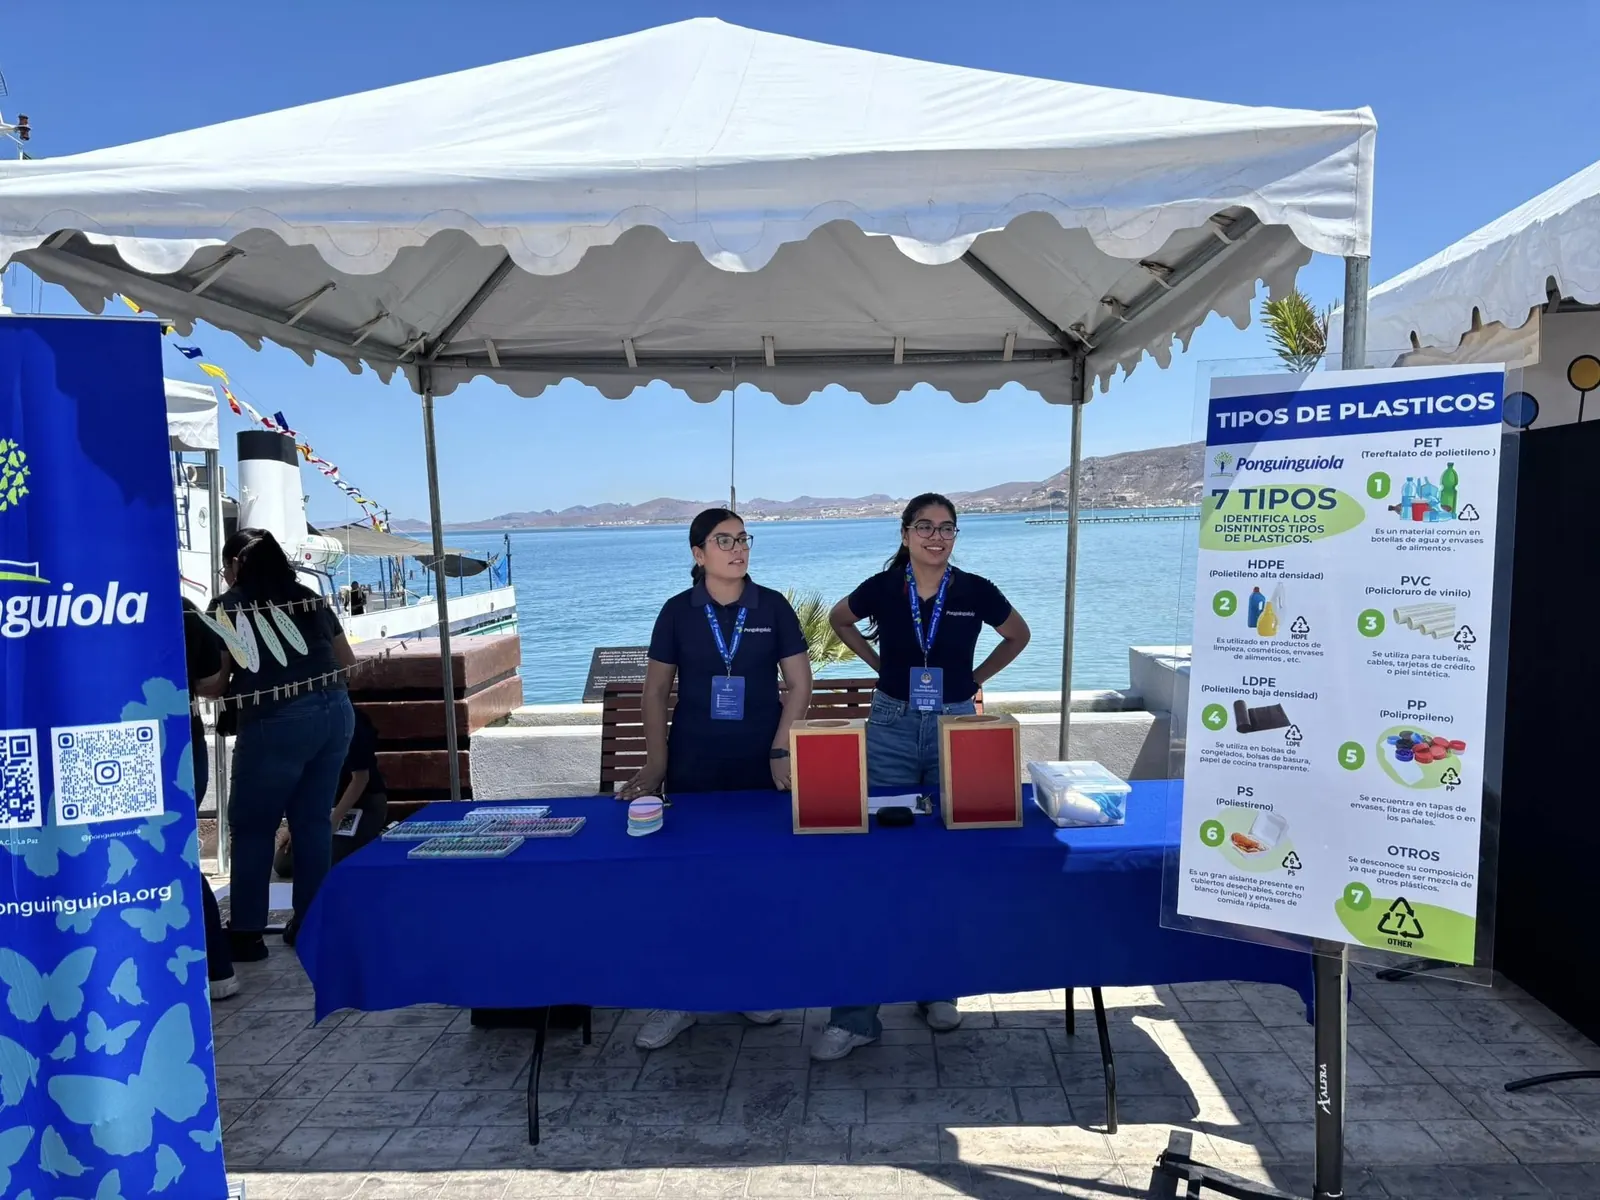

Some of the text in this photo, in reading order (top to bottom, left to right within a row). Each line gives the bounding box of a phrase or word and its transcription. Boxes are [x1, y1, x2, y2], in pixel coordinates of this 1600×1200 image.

[1216, 392, 1495, 429] TIPOS DE PLASTICOS
[1414, 437, 1442, 448] PET
[1361, 450, 1417, 459] (Tereftalato
[1436, 448, 1490, 458] polietileno
[1236, 455, 1344, 473] Ponguinguiola
[1374, 478, 1382, 492] 1
[1212, 488, 1337, 510] 7 TIPOS
[1223, 514, 1317, 523] IDENTIFICA LOS
[1215, 524, 1325, 533] DISNTINTOS TIPOS
[1224, 534, 1313, 544] DE PLASTICOS.
[1248, 559, 1285, 570] HDPE
[1279, 572, 1324, 580] densidad)
[1400, 576, 1431, 586] PVC
[1365, 587, 1421, 595] (Policloruro
[1440, 589, 1471, 598] vinilo)
[0, 581, 148, 638] guiola
[1220, 598, 1230, 610] 2
[1365, 616, 1377, 630] 3
[1271, 640, 1309, 648] productos
[1247, 647, 1291, 655] cosméticos,
[1245, 654, 1281, 662] alimentos
[1432, 653, 1470, 663] tuberías,
[1397, 661, 1428, 669] tarjetas
[1444, 662, 1475, 671] crédito
[1412, 669, 1450, 678] sintética.
[1242, 676, 1276, 687] LDPE
[1201, 685, 1318, 700] (Polietileno baja densidad)
[1407, 700, 1427, 710] PP
[1208, 710, 1221, 724] 4
[1380, 710, 1454, 723] (Polipropileno)
[1226, 742, 1248, 750] utiliza
[1201, 749, 1244, 758] congelados,
[1283, 756, 1311, 764] basura,
[1346, 749, 1357, 763] 5
[1259, 762, 1309, 772] transparente.
[1237, 786, 1254, 797] PS
[1216, 798, 1274, 812] (Poliestireno)
[1371, 796, 1414, 806] encuentra
[1429, 803, 1453, 811] tapas
[1350, 802, 1385, 812] envases,
[1387, 806, 1410, 815] fibras
[1426, 811, 1454, 820] tejidos
[1401, 816, 1436, 826] pañales.
[1207, 827, 1217, 840] 6
[1388, 846, 1440, 861] OTROS
[1360, 858, 1405, 870] desconoce
[1419, 867, 1474, 880] composición
[1229, 875, 1257, 884] aislante
[1260, 880, 1293, 888] presente
[1377, 877, 1440, 892] otros plásticos.
[1379, 870, 1410, 879] pueden
[1428, 876, 1458, 886] mezcla
[1191, 877, 1302, 898] cubiertos desechables, corcho
[1220, 889, 1247, 899] (unicel)
[1256, 896, 1285, 904] envases
[1351, 889, 1363, 904] 7
[1217, 897, 1272, 910] comida rápida.
[1395, 913, 1406, 928] 7
[1388, 938, 1413, 948] OTHER
